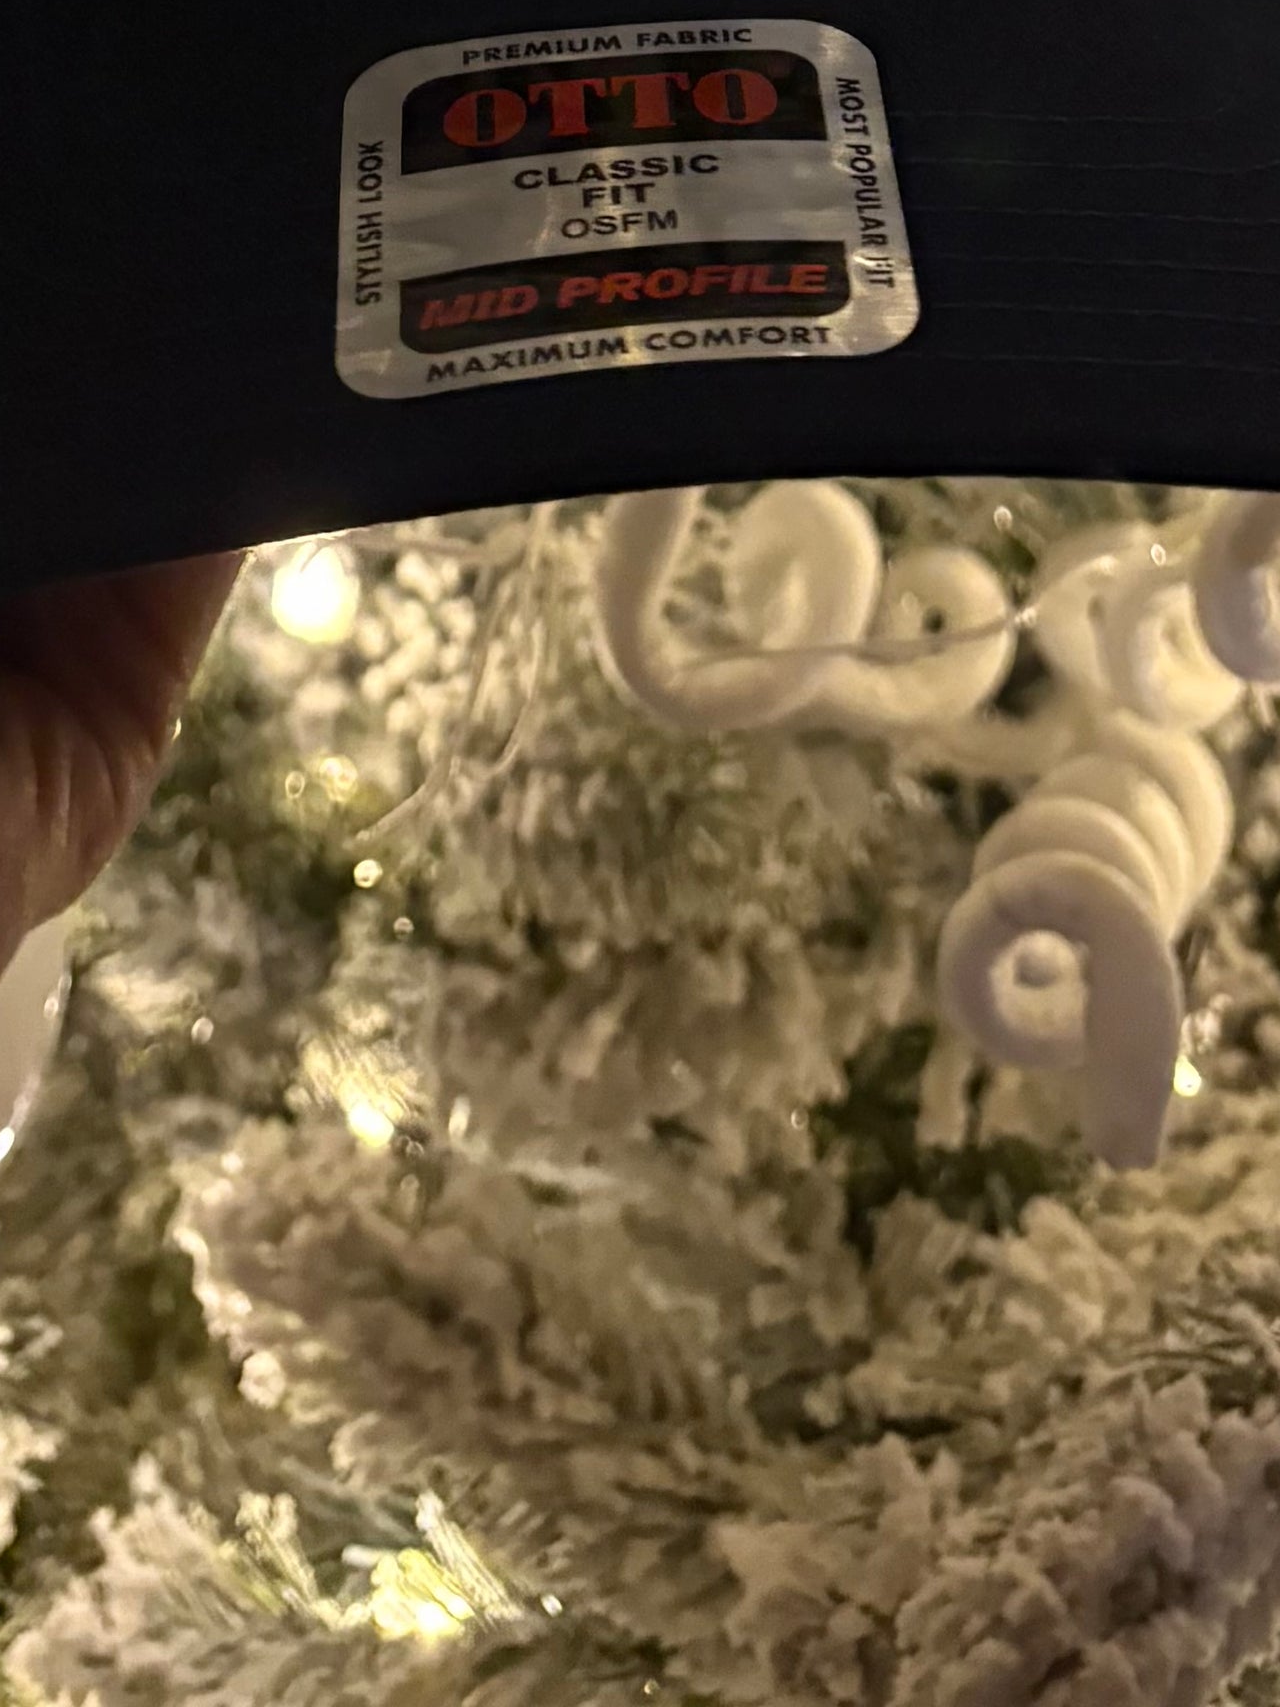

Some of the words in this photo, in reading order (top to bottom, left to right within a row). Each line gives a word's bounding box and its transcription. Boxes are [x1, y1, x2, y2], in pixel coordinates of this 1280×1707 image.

[462, 34, 622, 66] PREMIUM
[636, 27, 754, 49] FABRIC
[442, 68, 778, 149] OTTO
[835, 77, 868, 138] MOST
[357, 140, 385, 203] LOOK
[512, 153, 720, 190] CLASSIC
[581, 183, 656, 208] FIT
[846, 142, 889, 248] POPULAR
[561, 209, 679, 240] OSFM
[355, 211, 385, 305] STYLISH
[865, 254, 896, 289] FIT
[419, 284, 538, 331] MID
[556, 263, 829, 309] PROFILE
[426, 334, 629, 383] MAXIMUM
[643, 324, 832, 353] COMFORT
